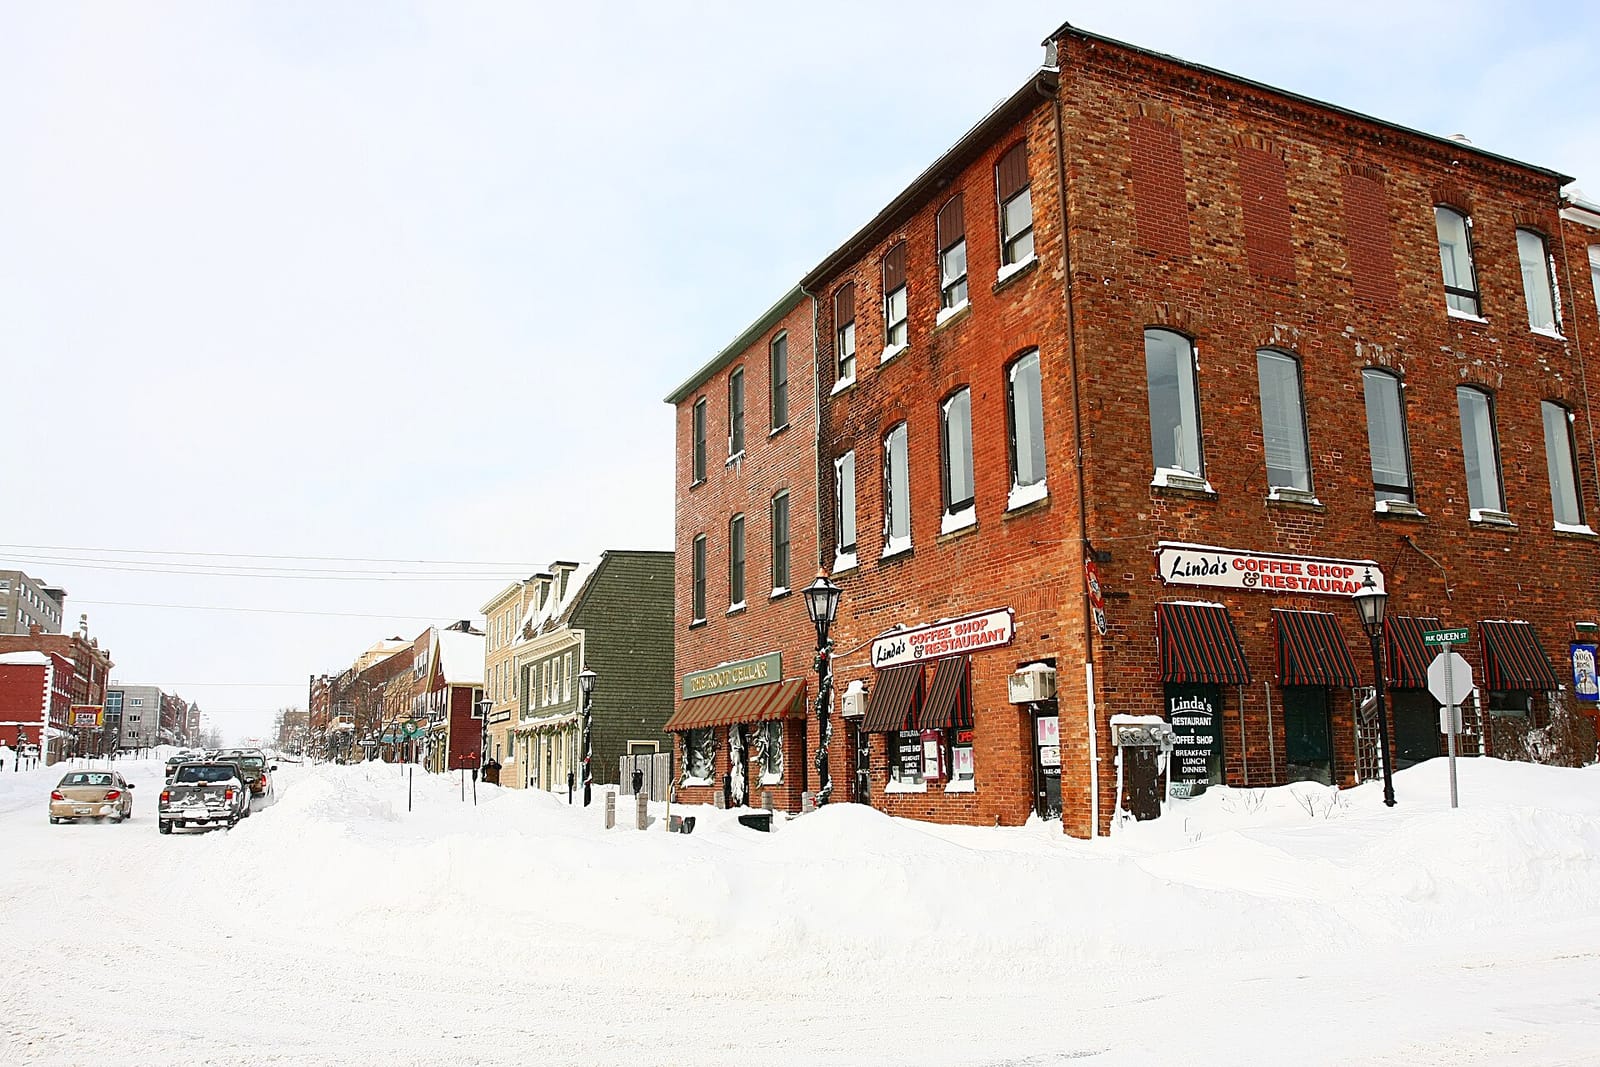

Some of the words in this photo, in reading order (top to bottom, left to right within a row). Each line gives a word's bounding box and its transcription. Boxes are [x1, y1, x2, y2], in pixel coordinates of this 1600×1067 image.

[1169, 555, 1228, 579] Linda's
[1232, 557, 1302, 577] COFFEE
[1306, 563, 1355, 579] SHOP
[1242, 571, 1260, 588] &
[1261, 574, 1363, 594] RESTAURA
[875, 639, 907, 666] Linda's
[908, 627, 953, 646] COFFEE
[954, 618, 989, 637] SHOP
[913, 645, 925, 659] &
[924, 628, 1006, 656] RESTAURANT
[1436, 632, 1460, 642] QUEEN
[1575, 653, 1593, 661] YOGA
[690, 675, 706, 693] THE
[707, 670, 731, 689] ROOT
[732, 661, 768, 683] CELLAR
[1171, 695, 1213, 713] Linda's
[1172, 717, 1212, 726] RESTAURANT
[958, 732, 973, 743] OPE
[1196, 736, 1213, 745] SHOP
[1169, 787, 1190, 796] OPEN
